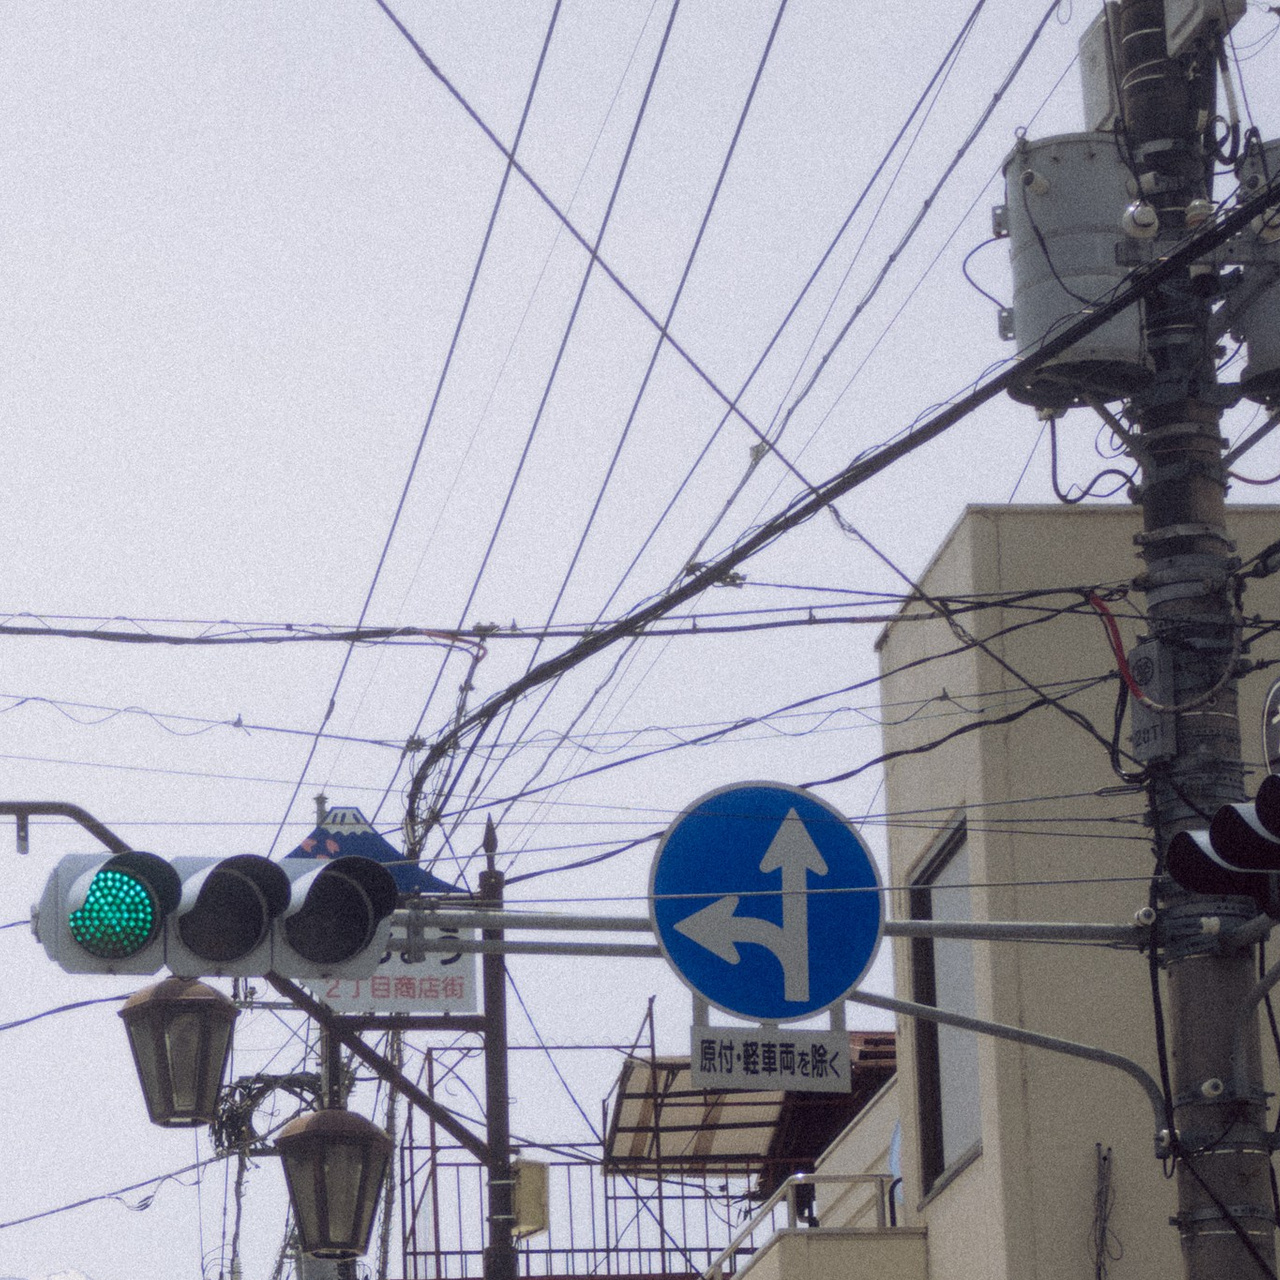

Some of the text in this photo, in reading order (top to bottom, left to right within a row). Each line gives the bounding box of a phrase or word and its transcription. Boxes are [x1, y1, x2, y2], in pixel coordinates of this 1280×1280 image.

[700, 1039, 840, 1079] 原付・軽車両を除く
